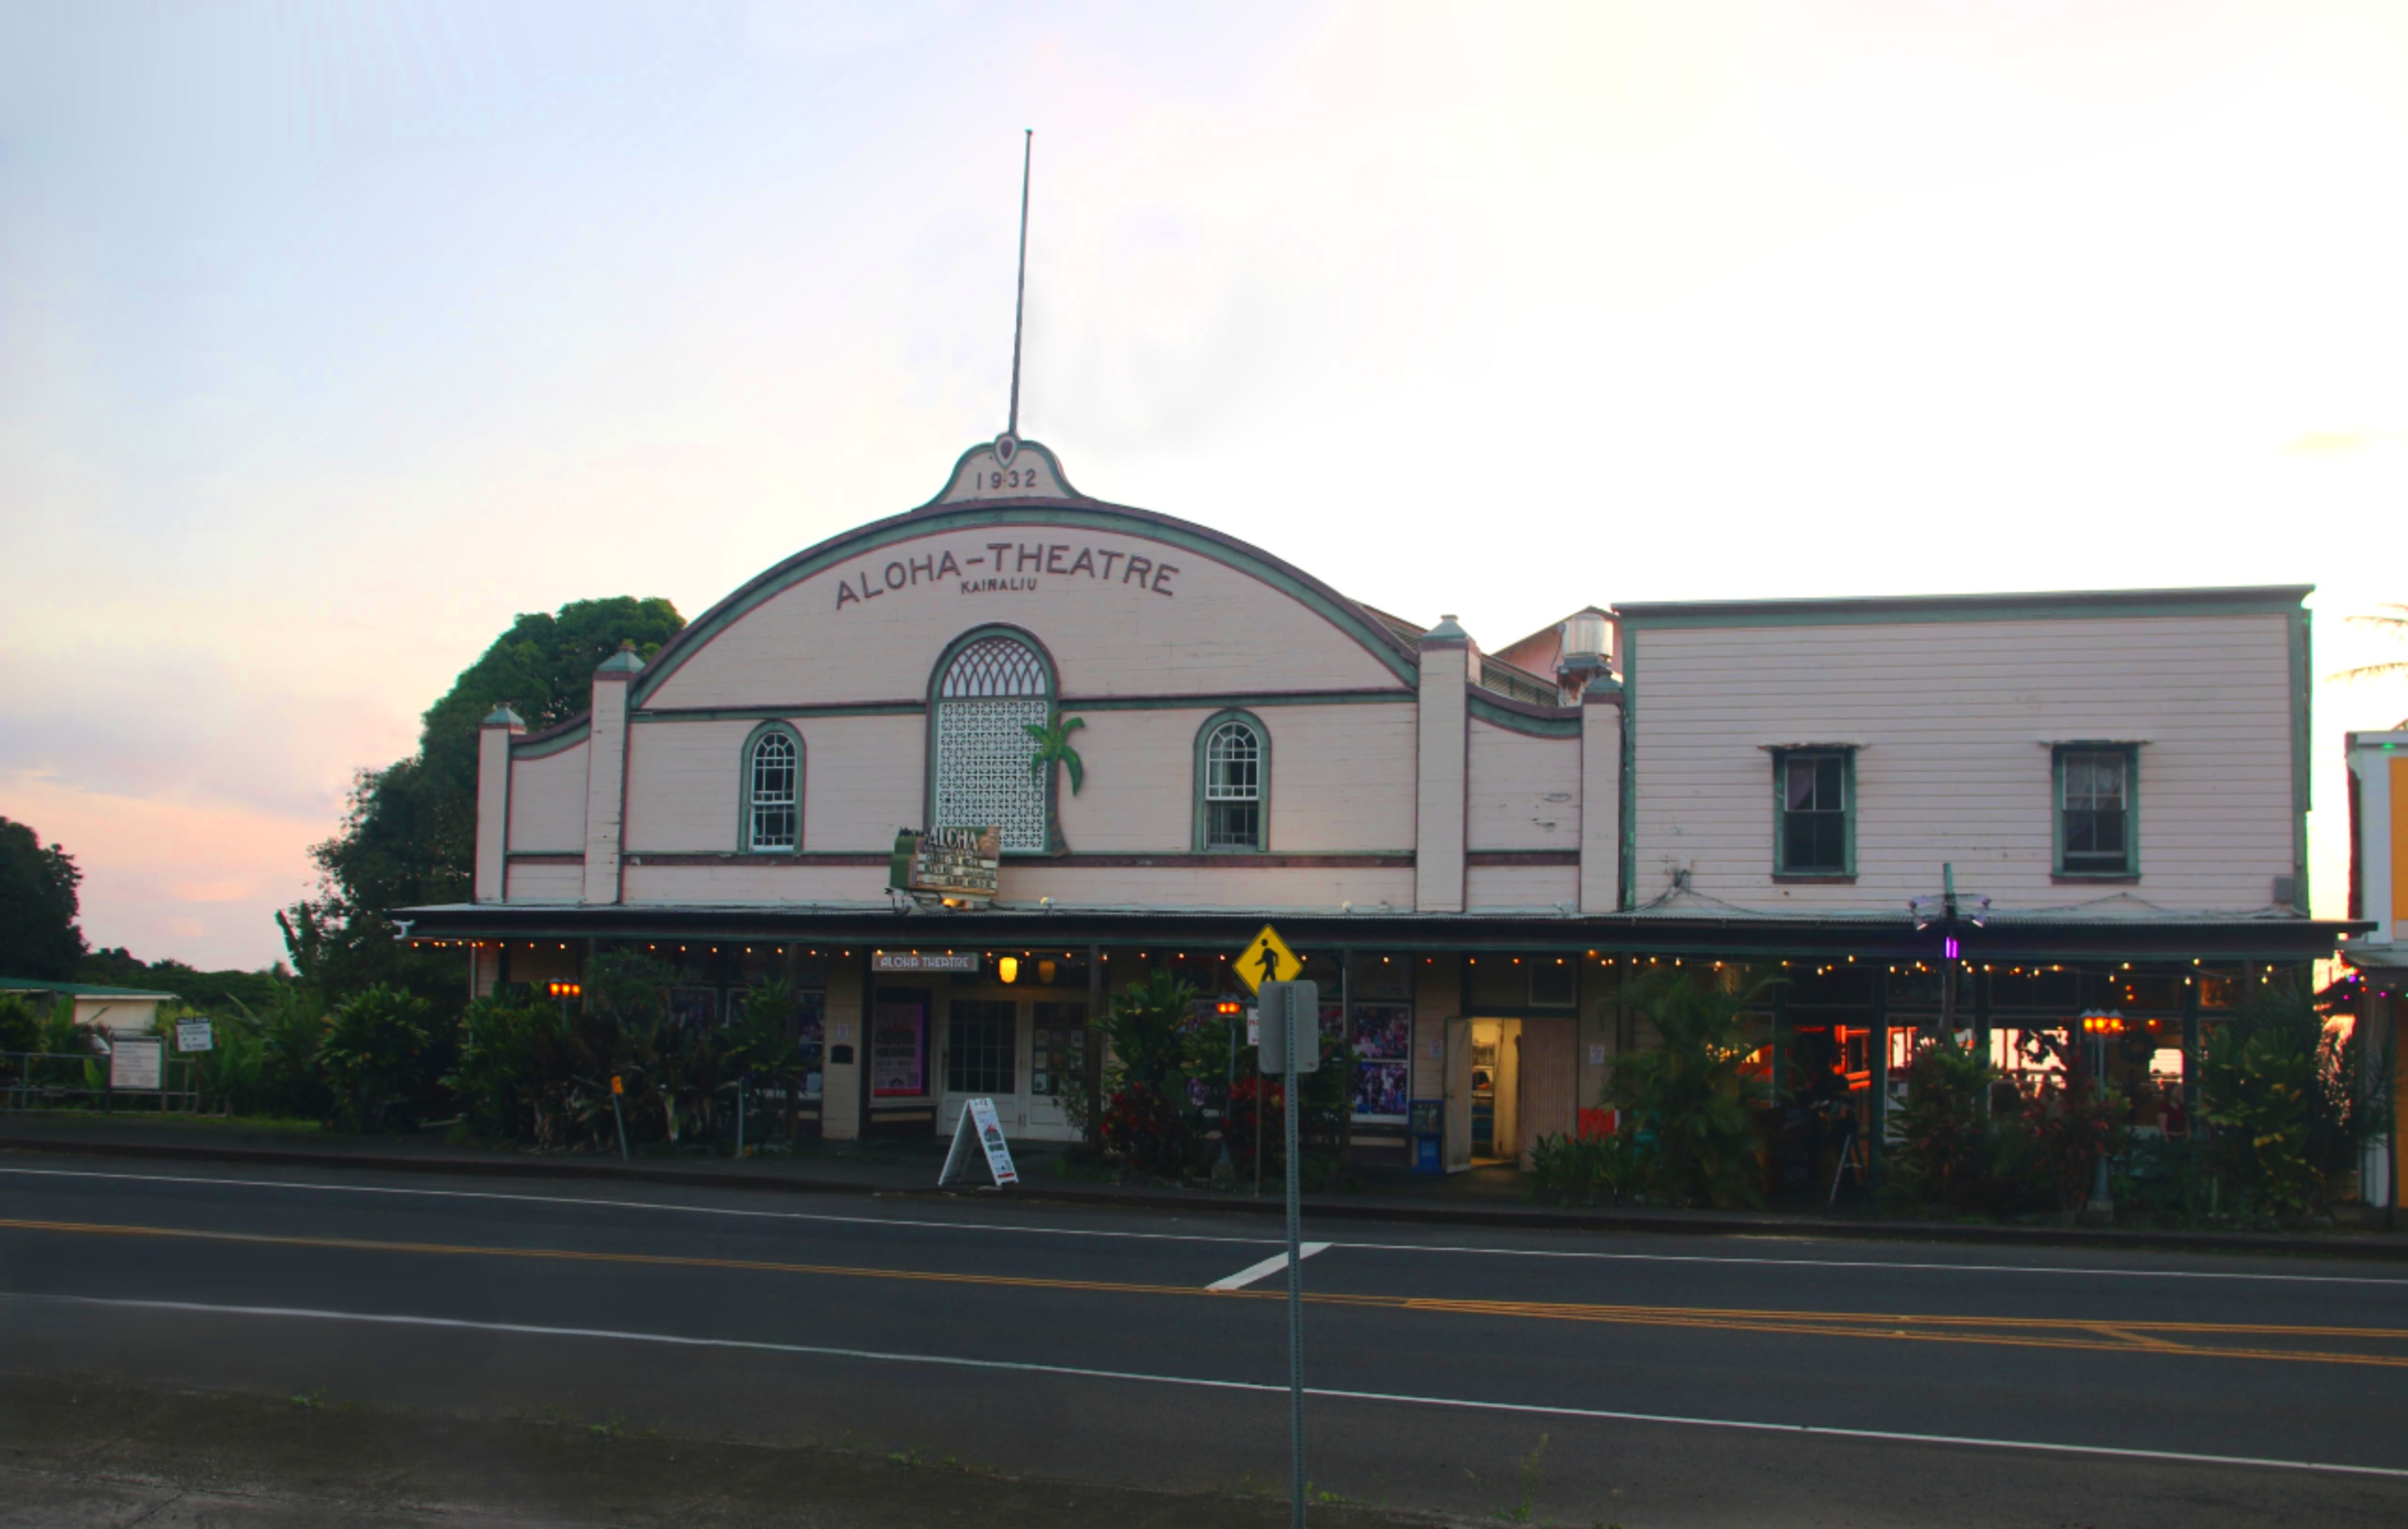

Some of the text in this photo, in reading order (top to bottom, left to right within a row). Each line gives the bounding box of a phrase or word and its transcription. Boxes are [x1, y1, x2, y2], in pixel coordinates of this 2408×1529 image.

[976, 469, 1036, 489] 1932
[961, 578, 1037, 594] KAINALIU
[927, 826, 978, 851] ALOHA
[880, 956, 969, 968] ALOHA THEATRE
